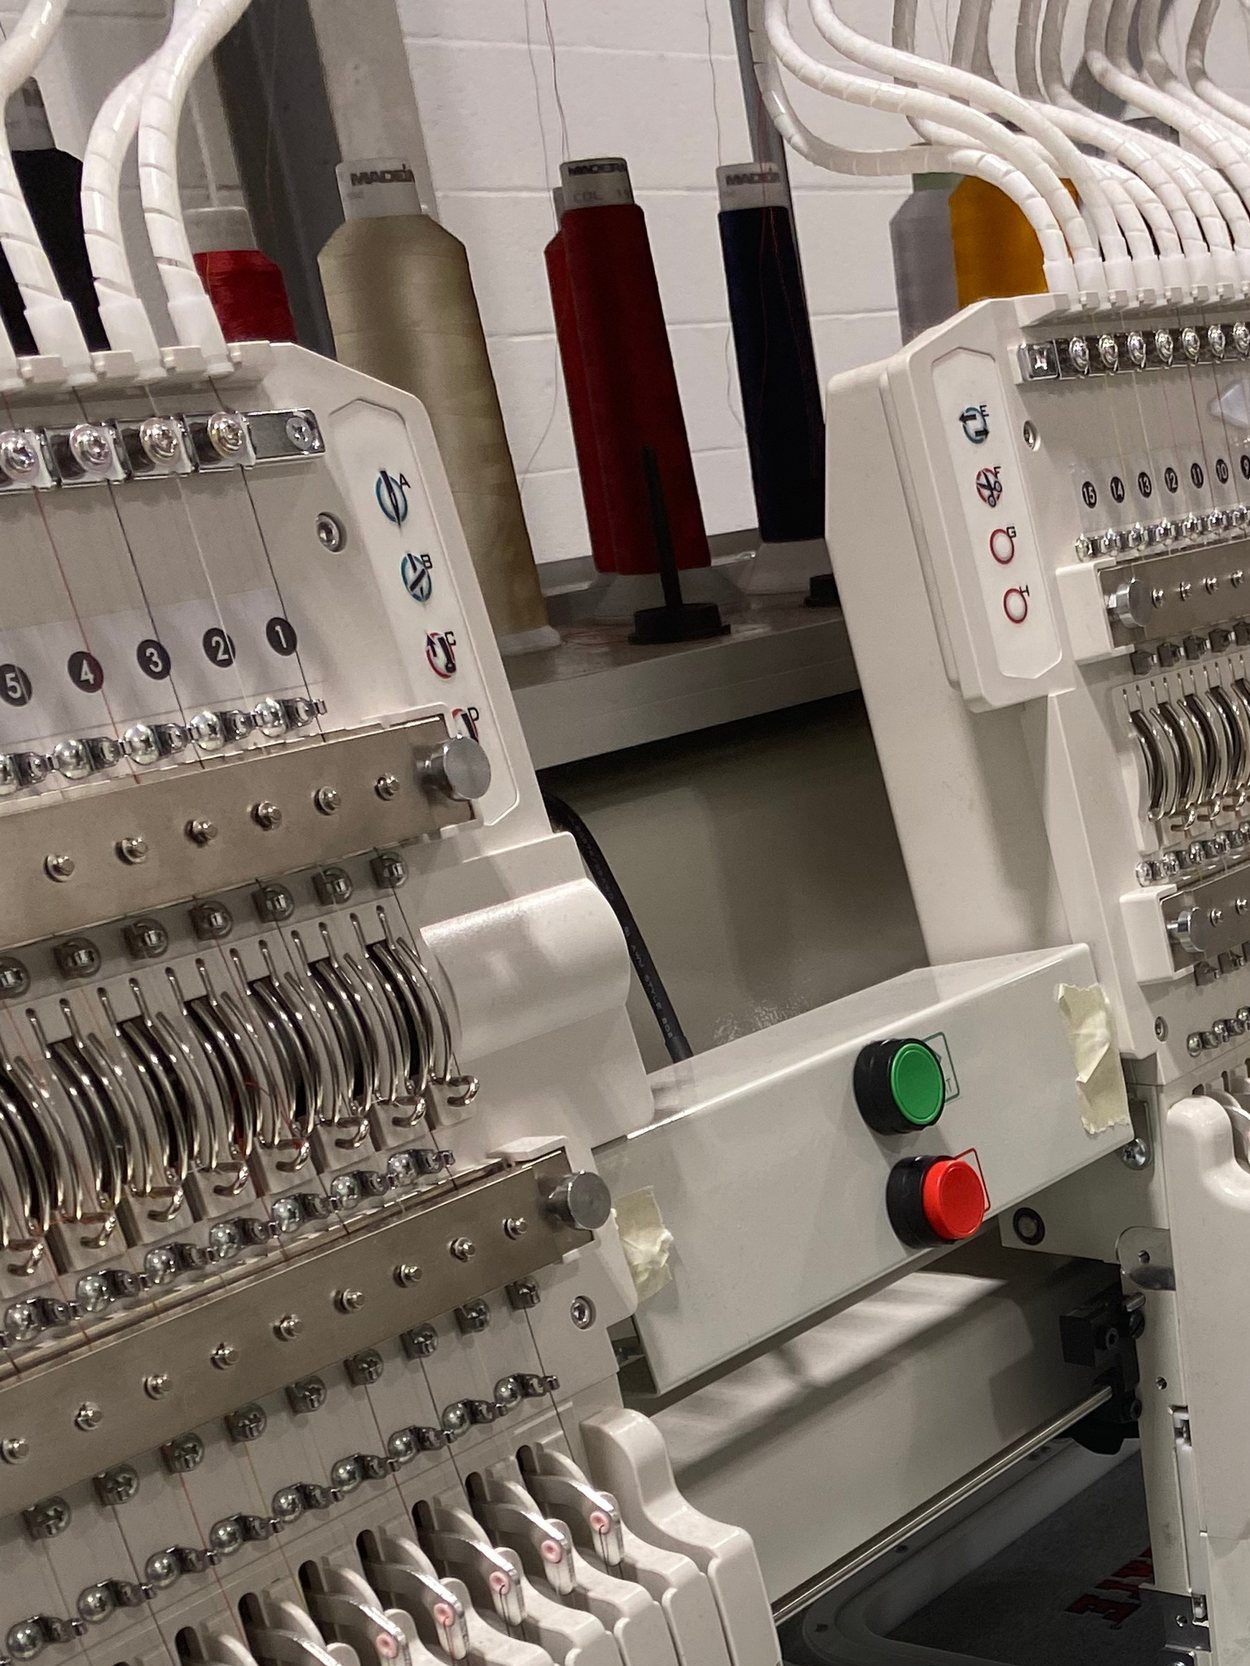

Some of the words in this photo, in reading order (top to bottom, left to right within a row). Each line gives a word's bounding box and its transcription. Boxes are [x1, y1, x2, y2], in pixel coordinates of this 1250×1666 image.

[5, 673, 22, 699] 5
[80, 660, 95, 685] 4
[145, 647, 162, 673] 3
[211, 637, 229, 661] 2
[274, 625, 288, 649] 1
